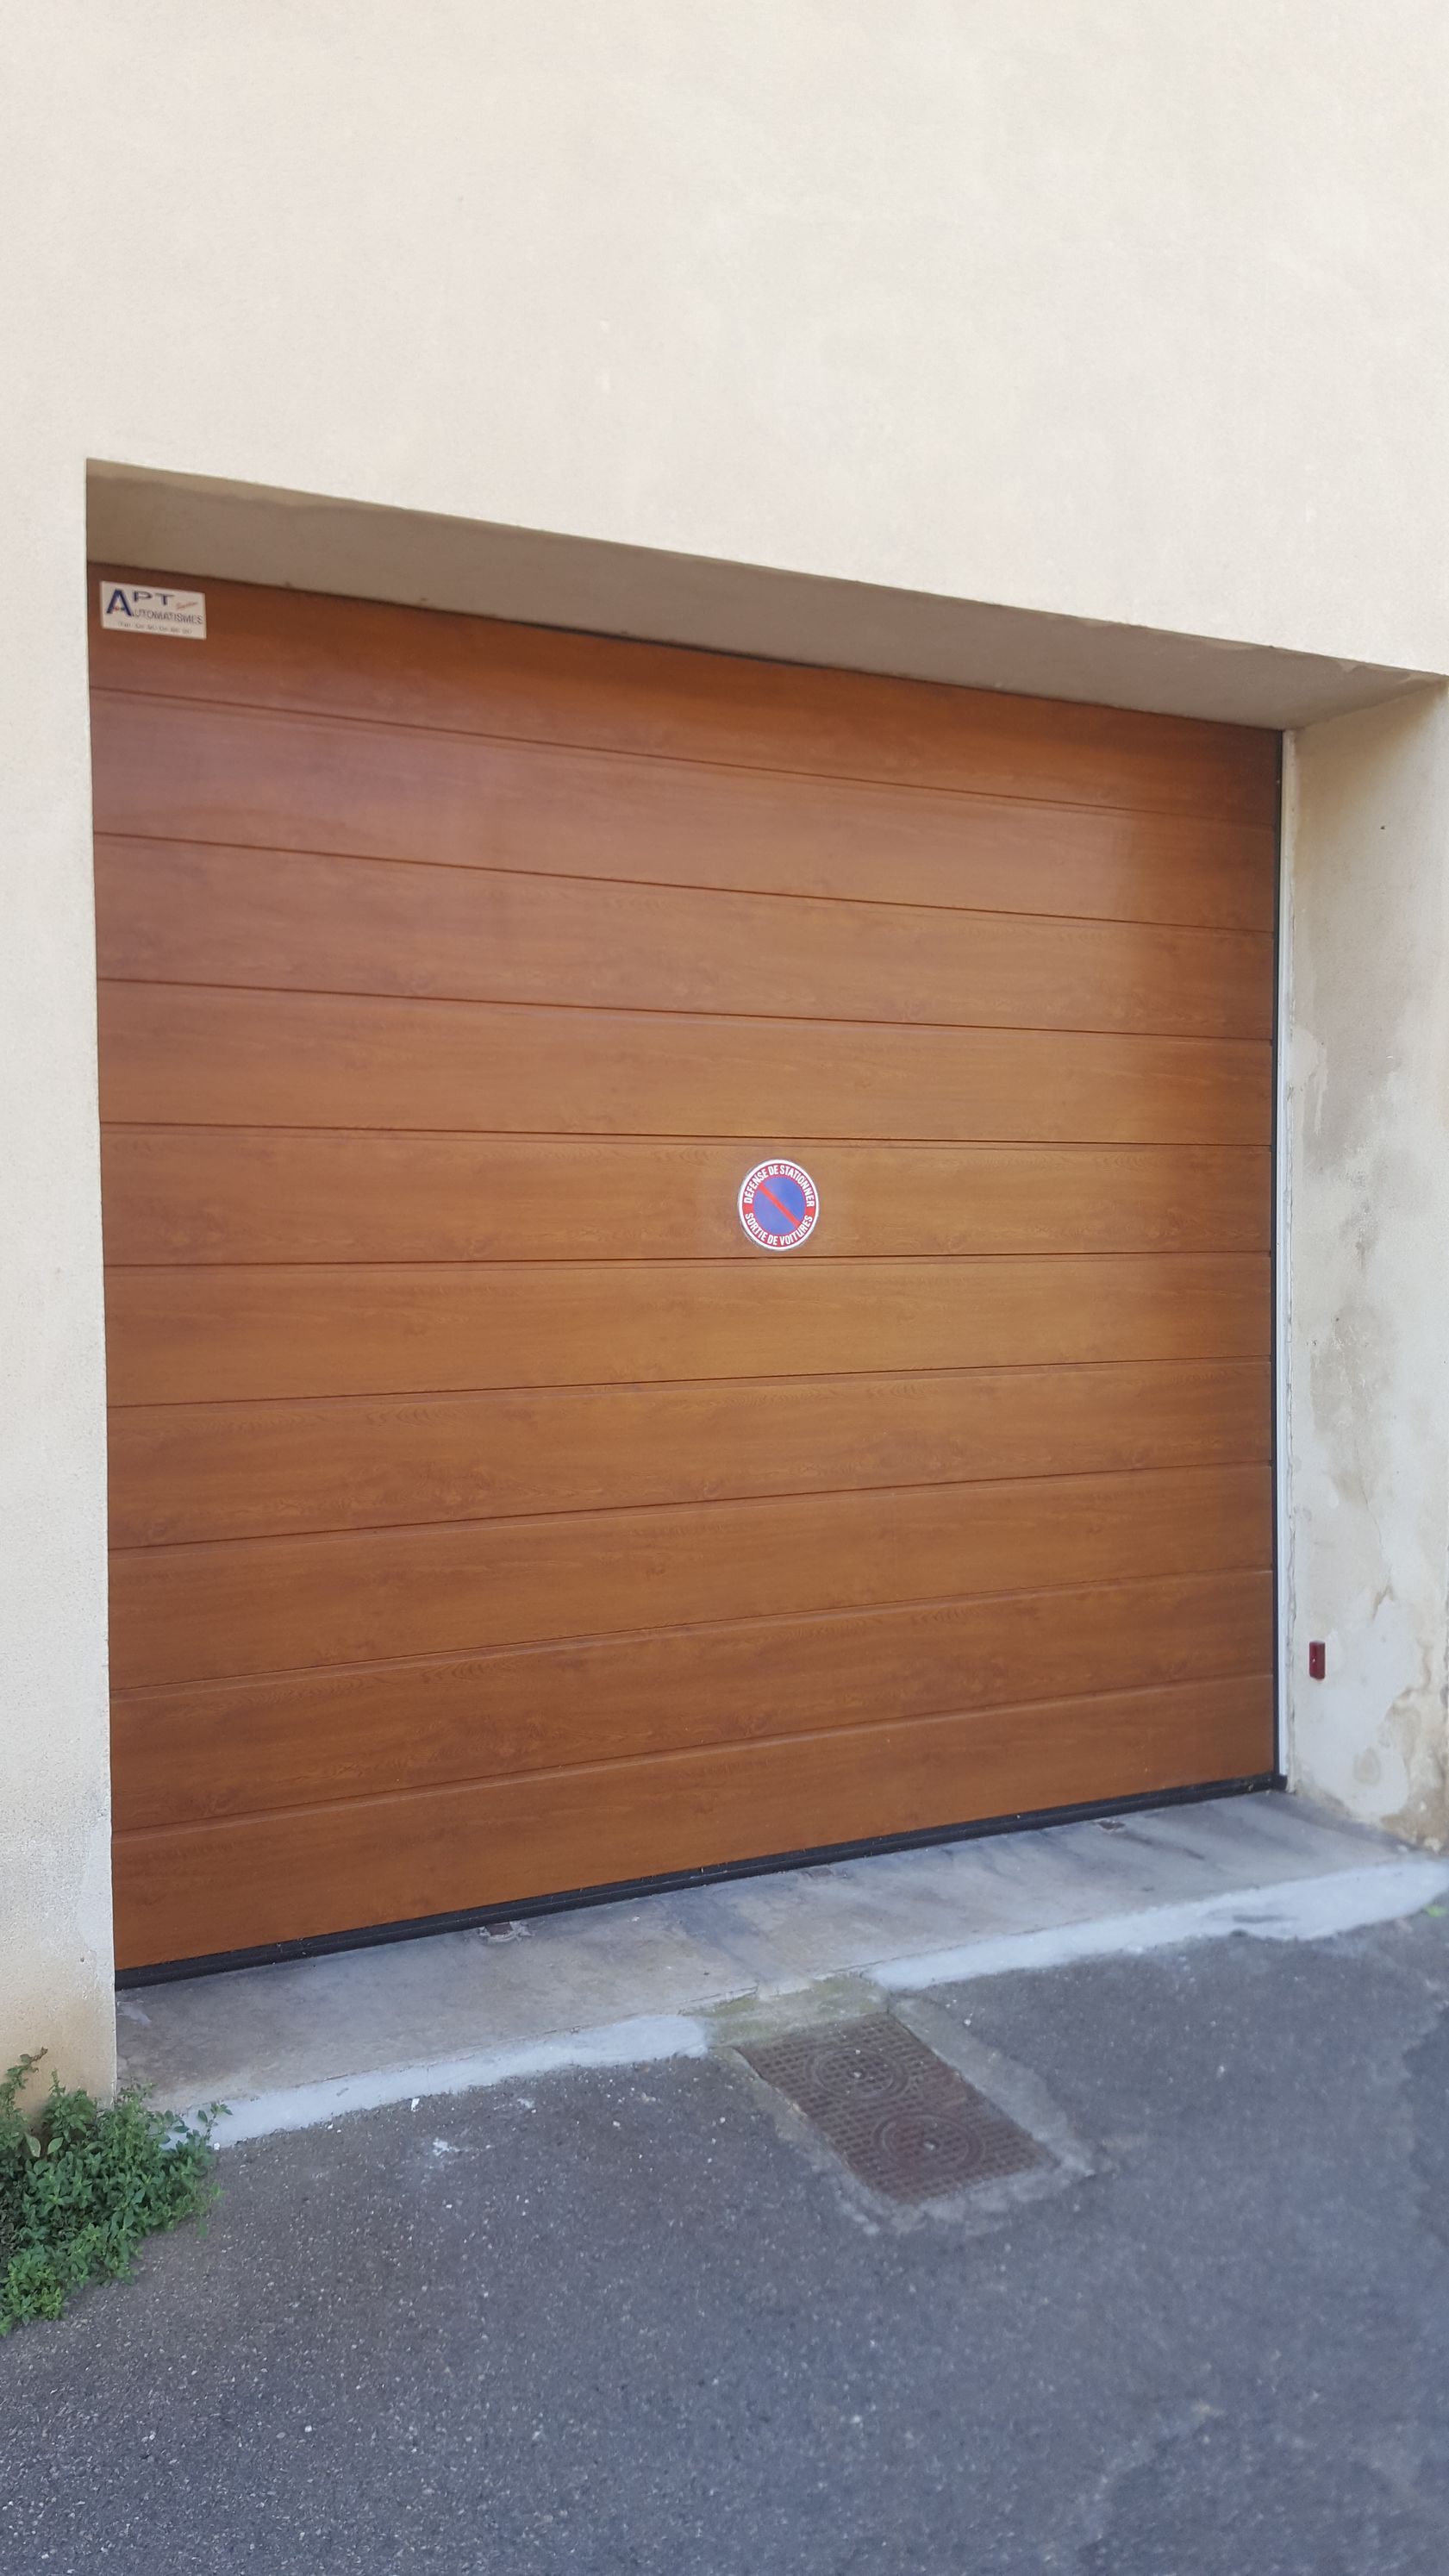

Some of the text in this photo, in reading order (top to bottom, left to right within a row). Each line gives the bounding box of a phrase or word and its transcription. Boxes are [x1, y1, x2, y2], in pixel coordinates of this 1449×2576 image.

[768, 1165, 778, 1175] DE
[780, 1165, 815, 1207] STATIONNER
[745, 1213, 813, 1246] SORTIE DE VOITURES
